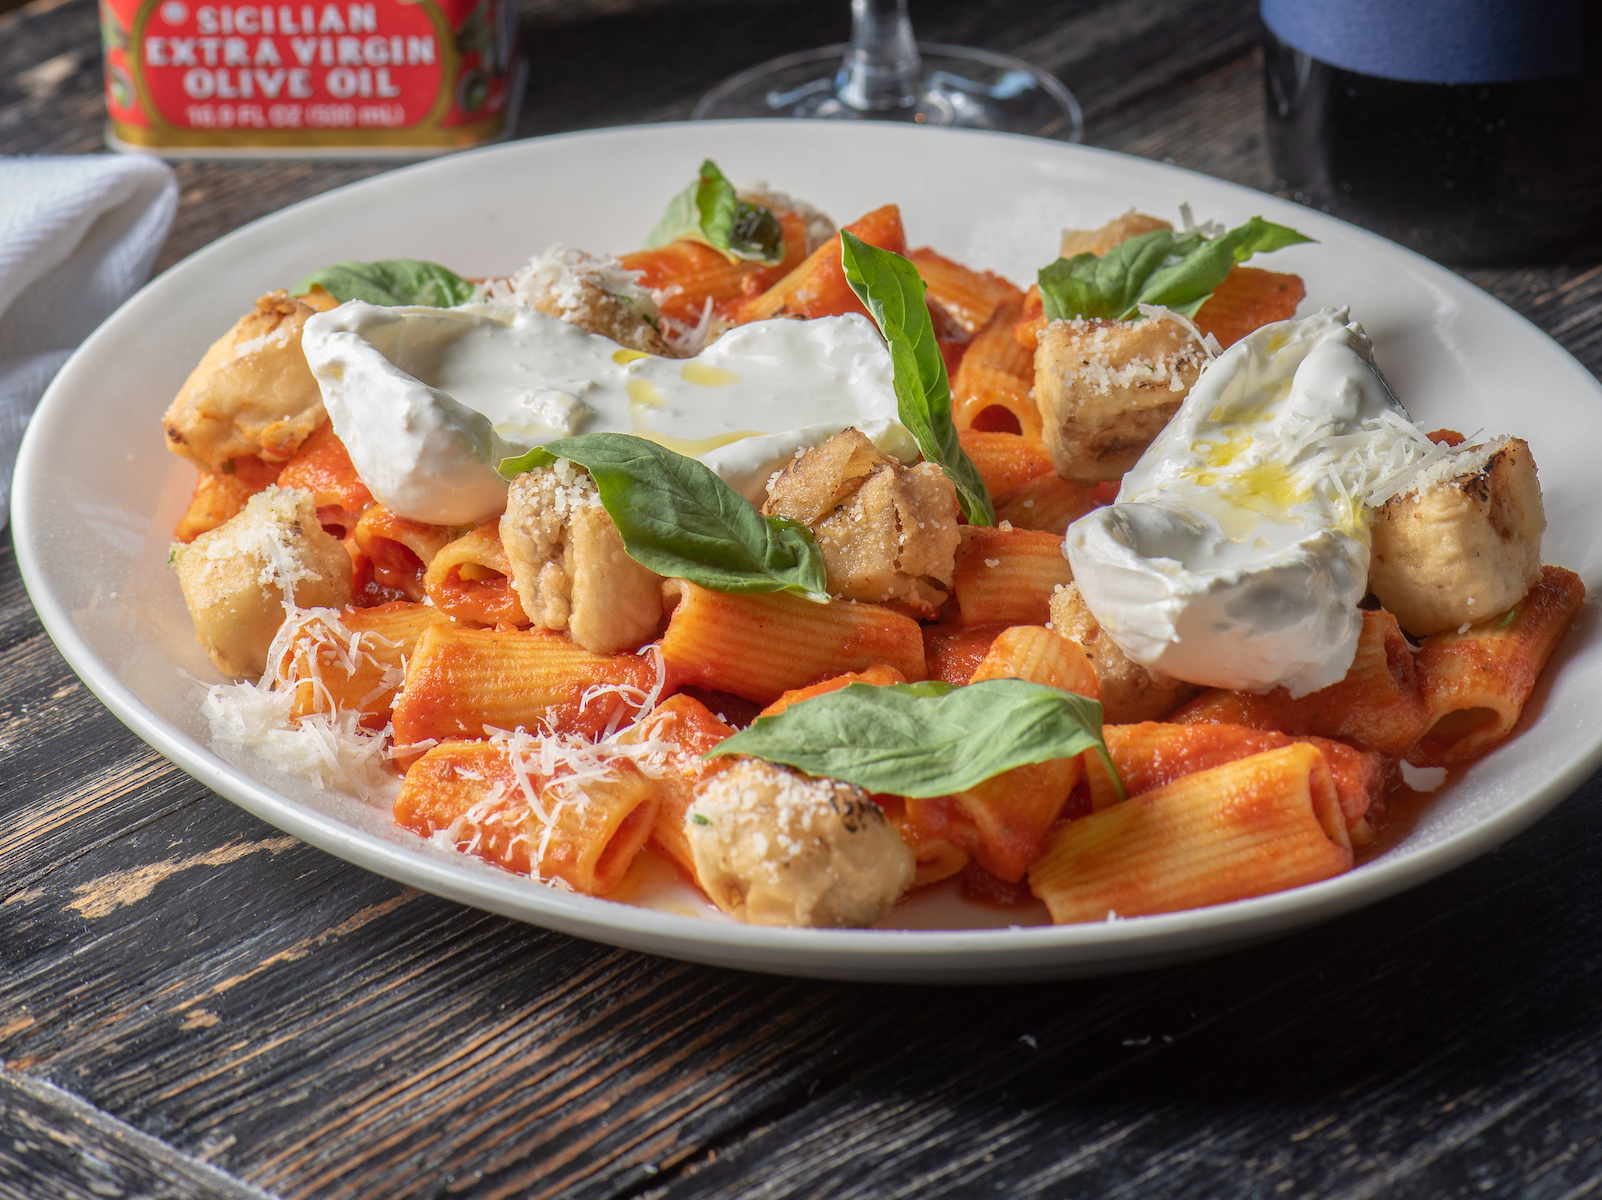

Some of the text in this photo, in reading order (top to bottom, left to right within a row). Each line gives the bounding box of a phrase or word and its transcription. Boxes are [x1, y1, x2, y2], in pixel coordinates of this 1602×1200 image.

[197, 3, 377, 35] SICILIAN
[146, 35, 436, 66] EXTRA VIRGIN
[183, 67, 401, 99] OLIVE OIL
